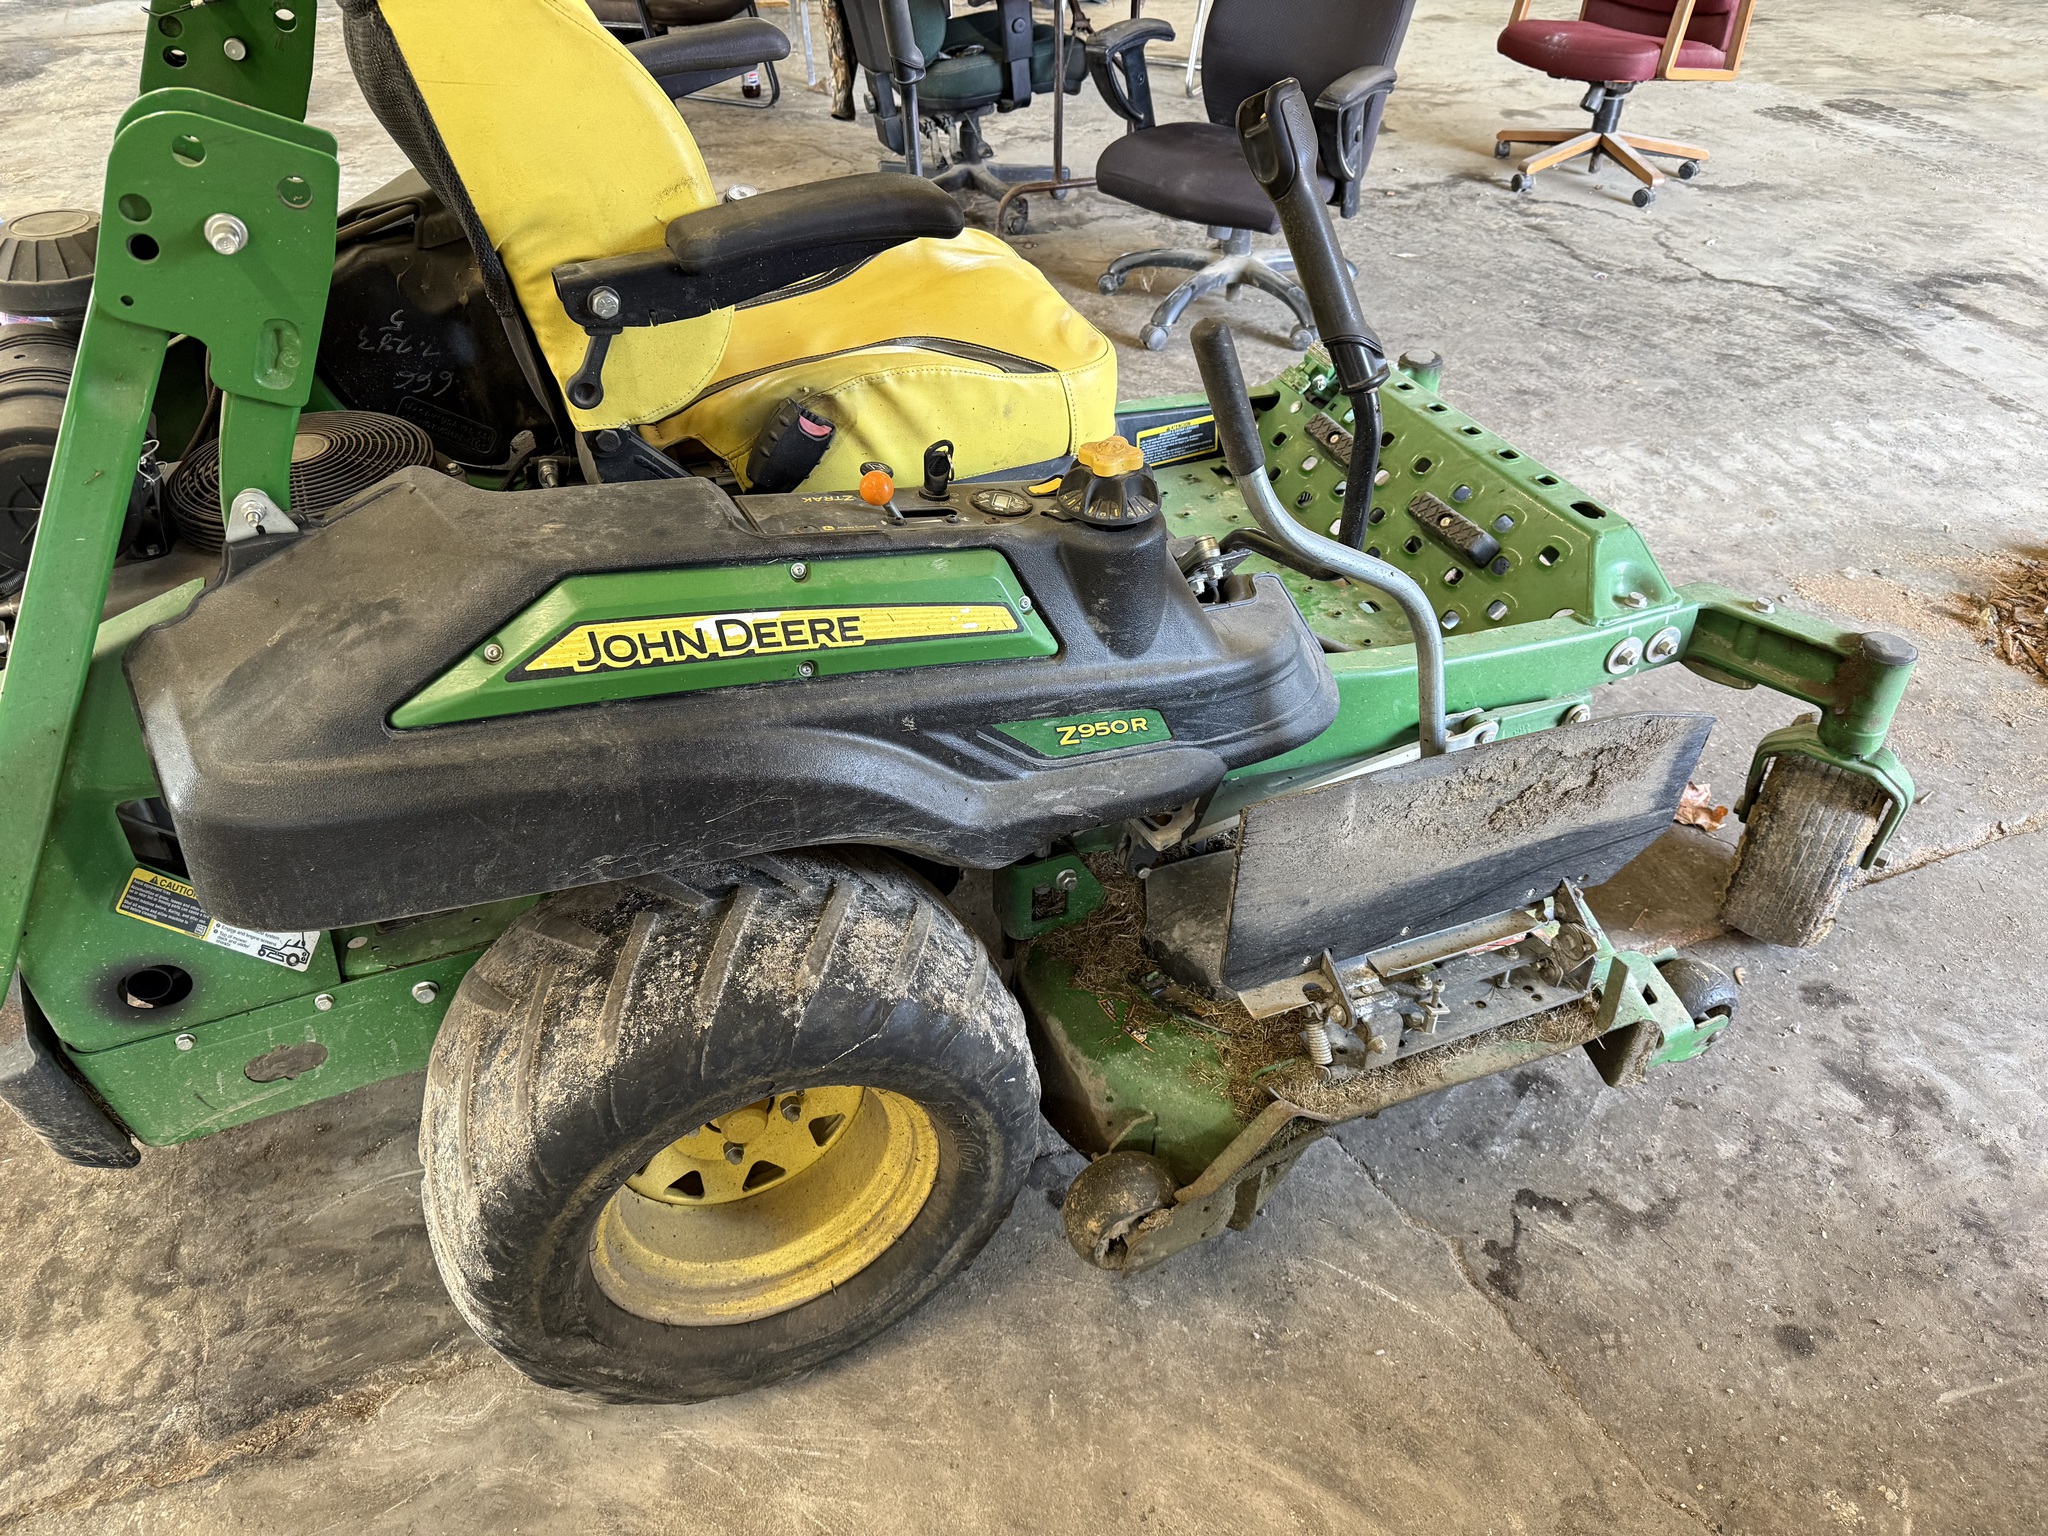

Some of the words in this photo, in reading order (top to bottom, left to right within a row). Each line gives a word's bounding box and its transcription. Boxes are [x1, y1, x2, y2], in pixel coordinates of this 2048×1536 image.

[577, 629, 706, 666] JOHN
[715, 615, 863, 652] DEERE
[1056, 717, 1149, 746] Z950R
[221, 925, 237, 934] Engine
